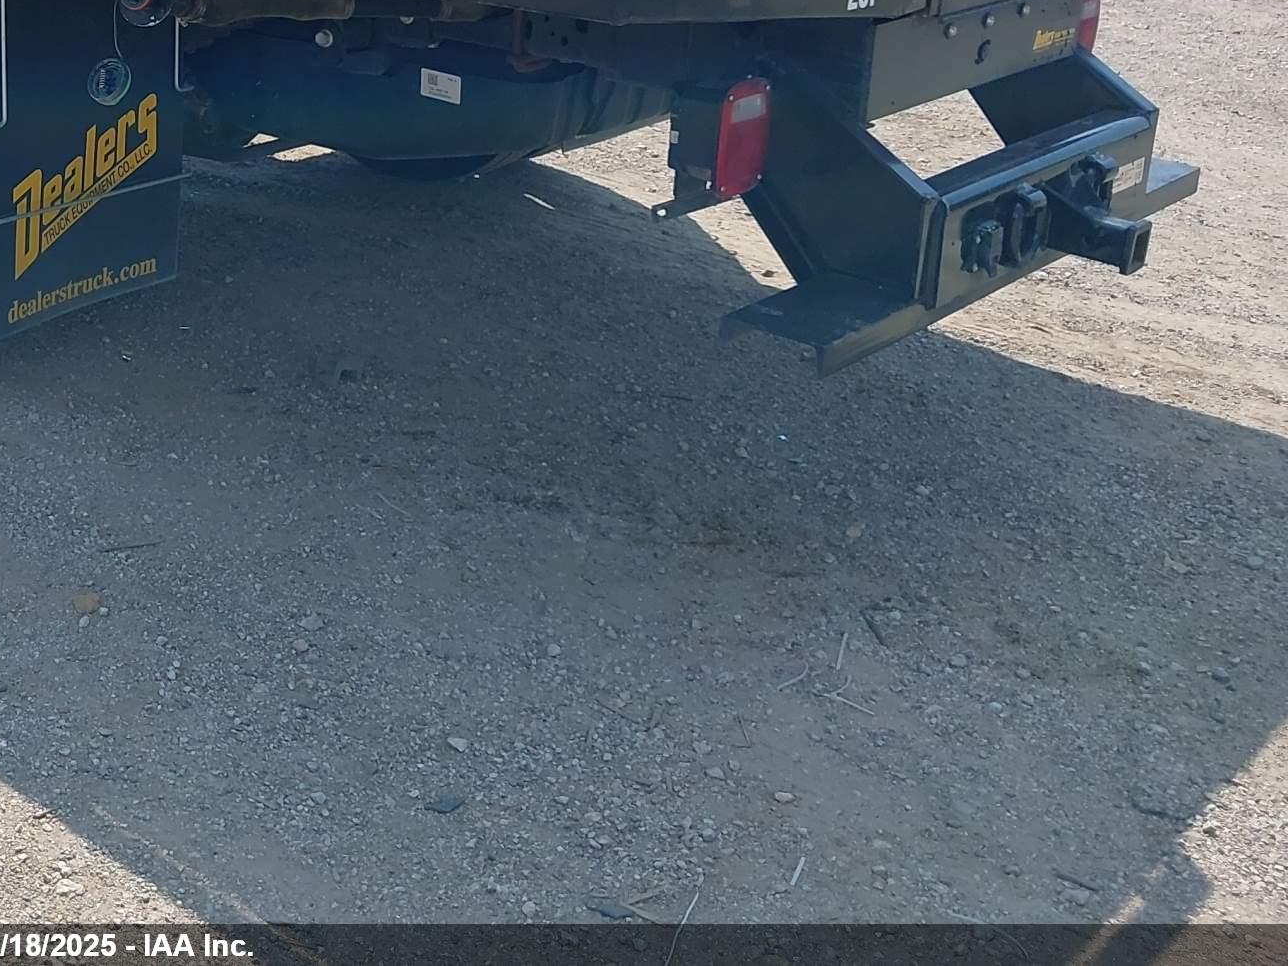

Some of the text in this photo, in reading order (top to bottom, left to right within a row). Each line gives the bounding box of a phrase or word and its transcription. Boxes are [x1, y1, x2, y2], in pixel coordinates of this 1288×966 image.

[12, 93, 158, 281] Dealers
[43, 211, 72, 245] TRUCK
[71, 170, 116, 220] EQUPMENT
[7, 257, 158, 324] dealerstruck.com
